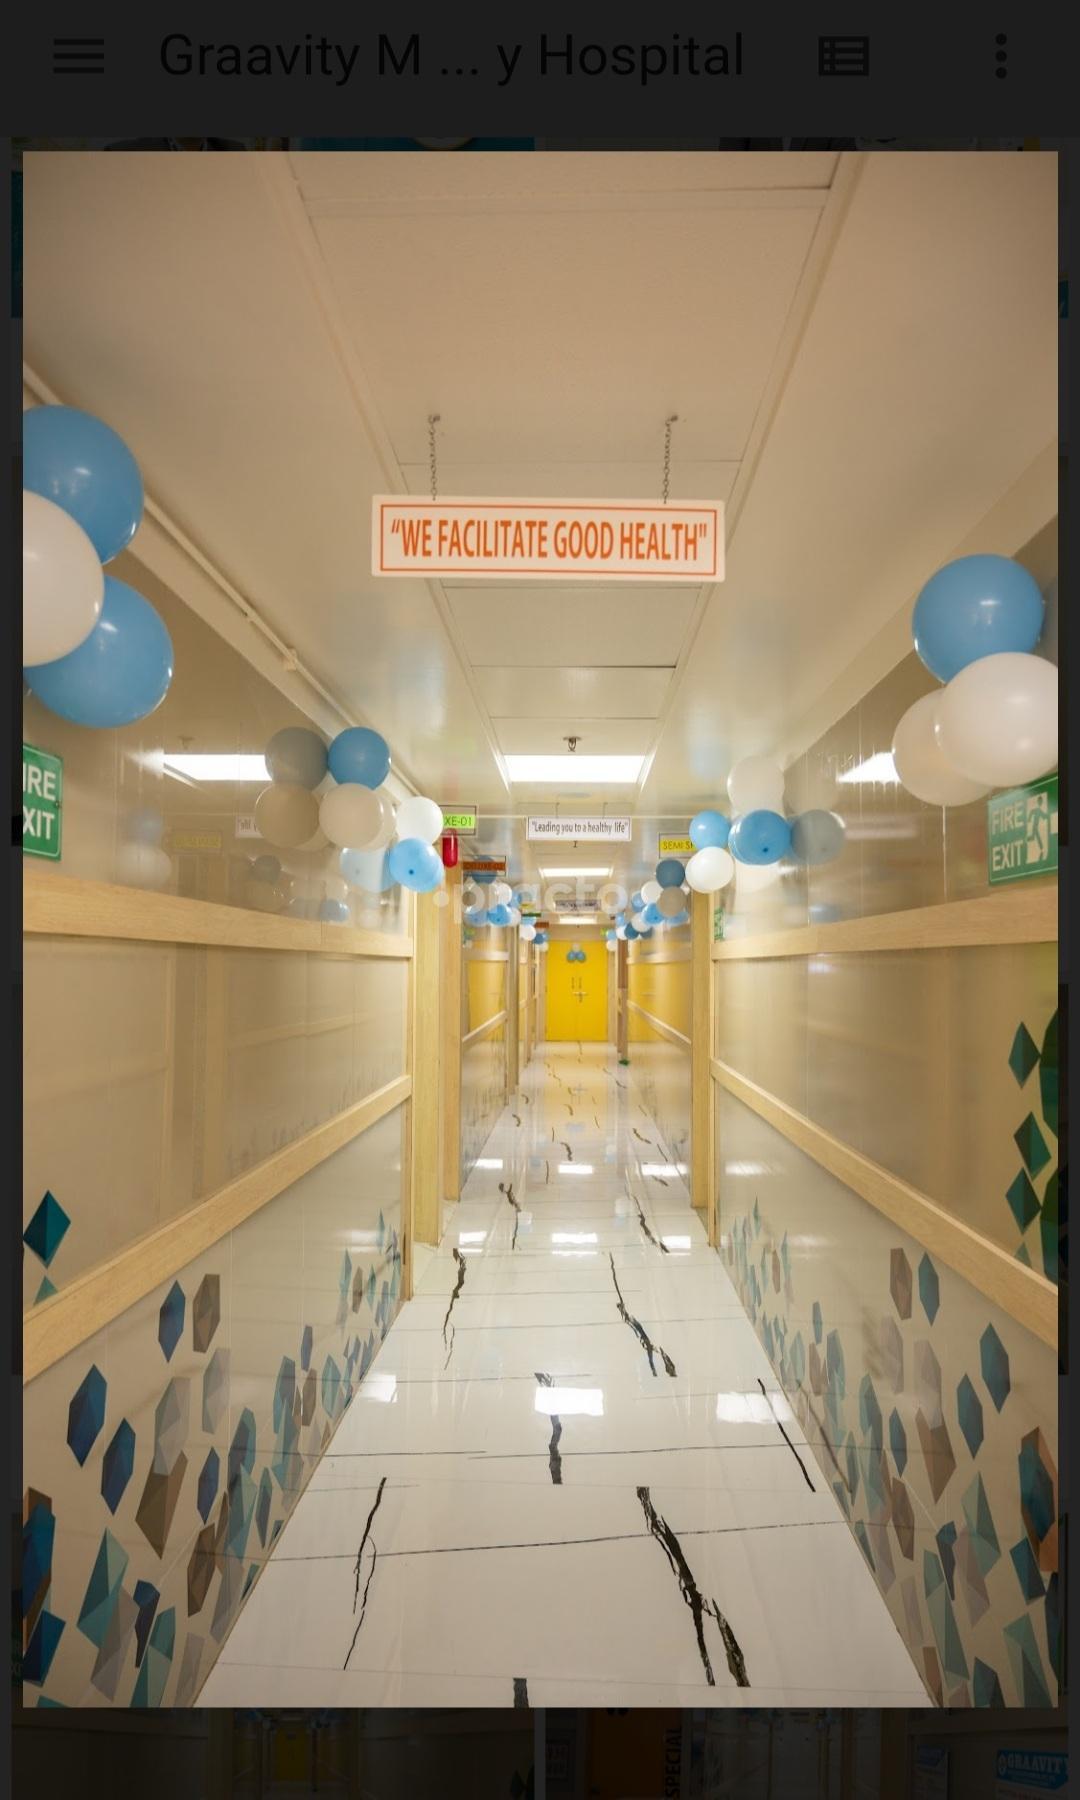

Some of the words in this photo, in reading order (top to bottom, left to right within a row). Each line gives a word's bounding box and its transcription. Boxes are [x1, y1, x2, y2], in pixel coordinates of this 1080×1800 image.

[438, 519, 548, 558] FACILITATE
[553, 520, 614, 560] GOOD
[561, 824, 573, 834] you
[574, 823, 582, 832] to
[588, 821, 612, 835] healthy
[992, 801, 1025, 835] FIRE
[992, 840, 1024, 872] EXIT
[1007, 1752, 1068, 1775] GRAAVIT
